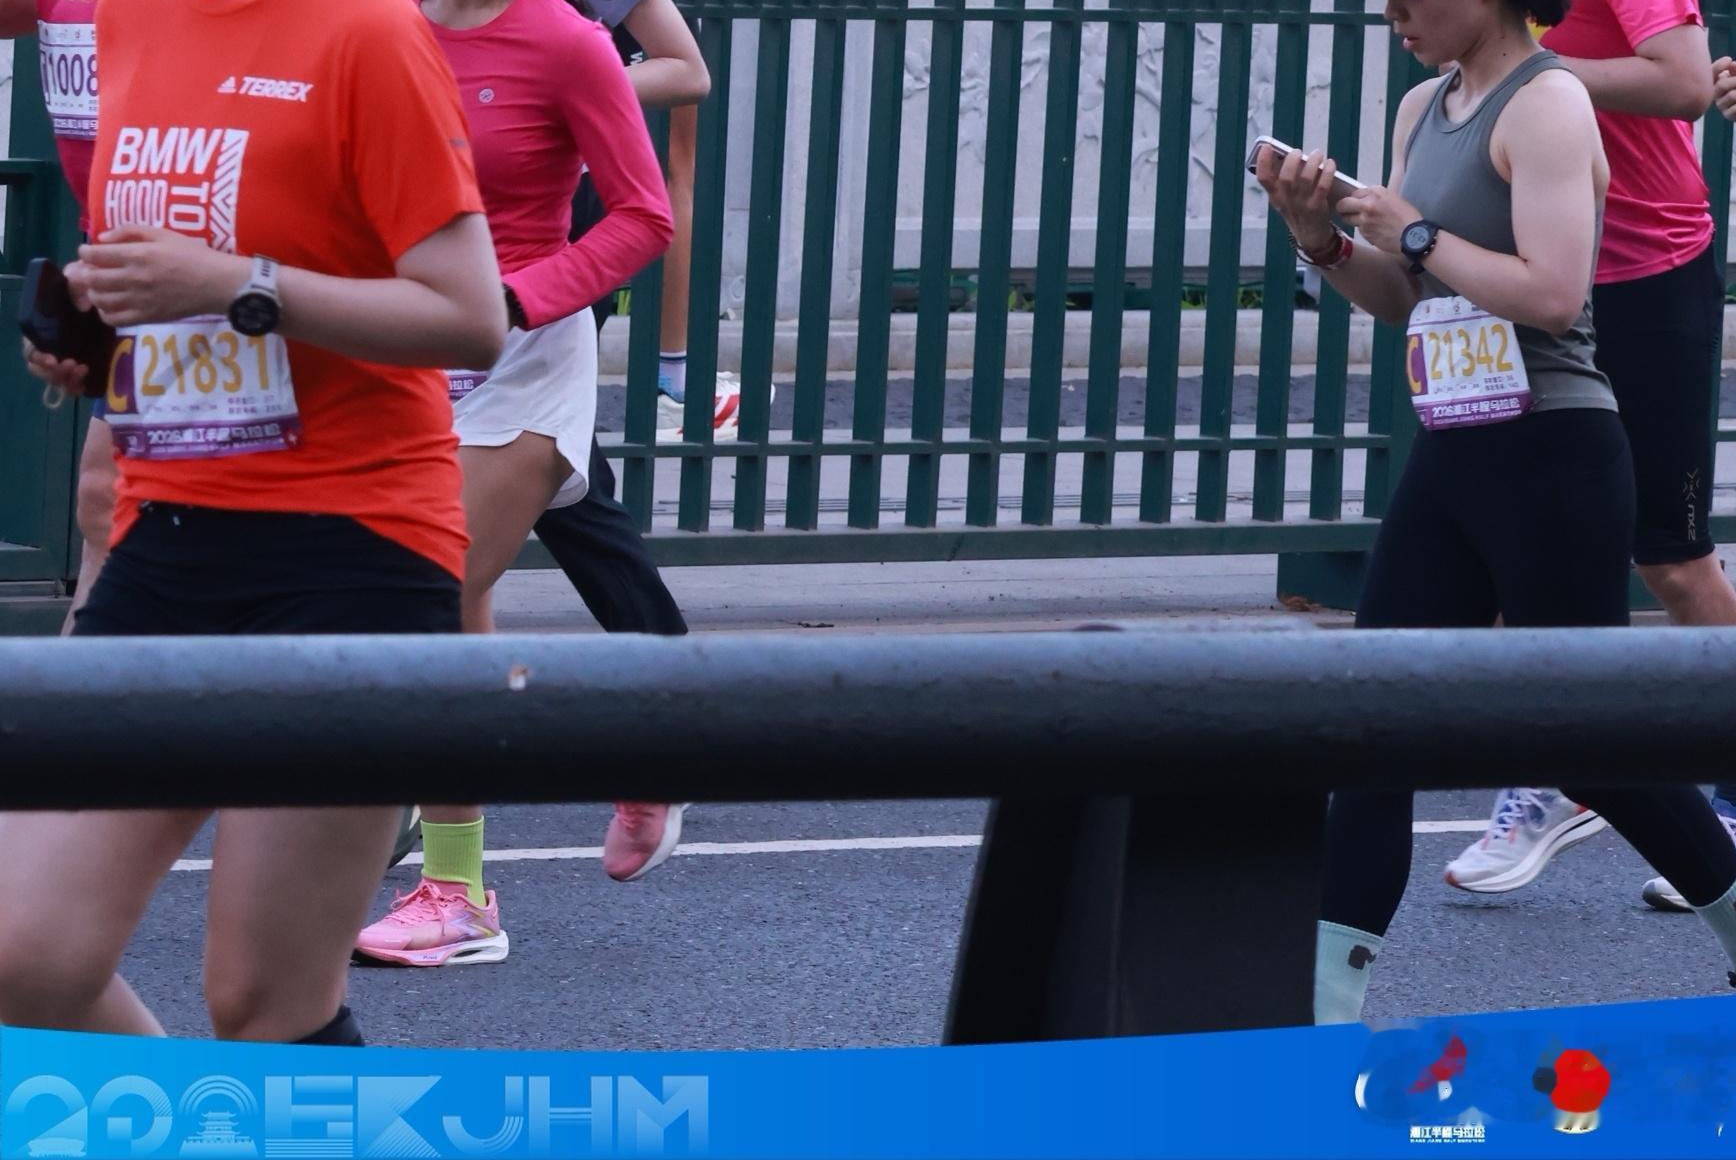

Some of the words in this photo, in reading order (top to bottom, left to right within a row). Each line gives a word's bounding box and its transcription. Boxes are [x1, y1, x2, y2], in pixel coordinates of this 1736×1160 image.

[239, 76, 314, 102] TERREX
[110, 127, 222, 174] BMW
[105, 178, 168, 229] HOOD
[106, 338, 133, 413] C
[140, 331, 270, 397] 21831
[1406, 335, 1422, 394] C
[1428, 323, 1514, 380] 21342
